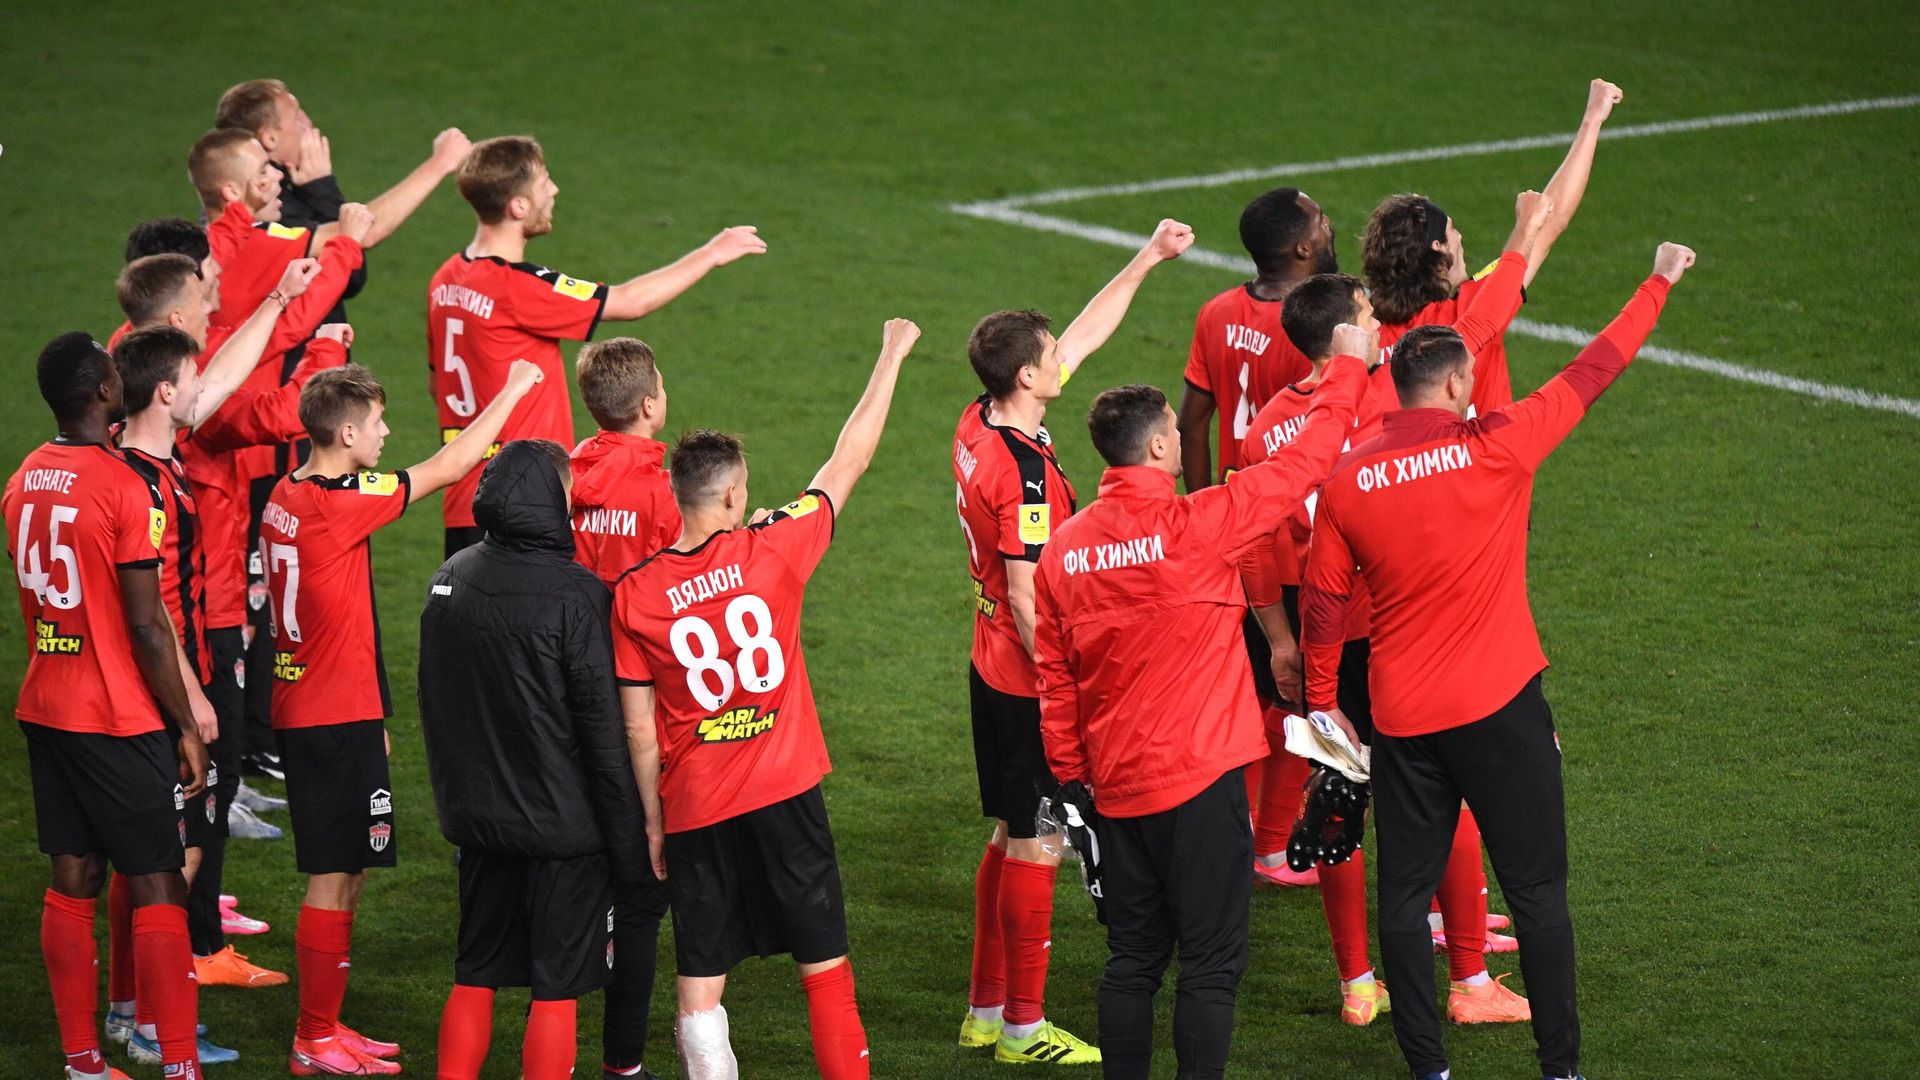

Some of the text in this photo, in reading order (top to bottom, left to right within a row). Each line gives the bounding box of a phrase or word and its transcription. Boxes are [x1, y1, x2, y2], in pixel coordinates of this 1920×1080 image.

[1226, 324, 1271, 356] ИДОВУ
[444, 318, 477, 417] 5
[23, 468, 78, 494] КОНАТЕ
[1357, 442, 1473, 493] ФК ХИМКИ
[579, 508, 637, 537] ХИМКИ
[17, 503, 82, 610] 45
[1063, 534, 1165, 576] ФК ХИМКИ
[666, 563, 744, 615] ДЯДЮН
[669, 594, 785, 712] 88
[370, 797, 392, 809] ПИК
